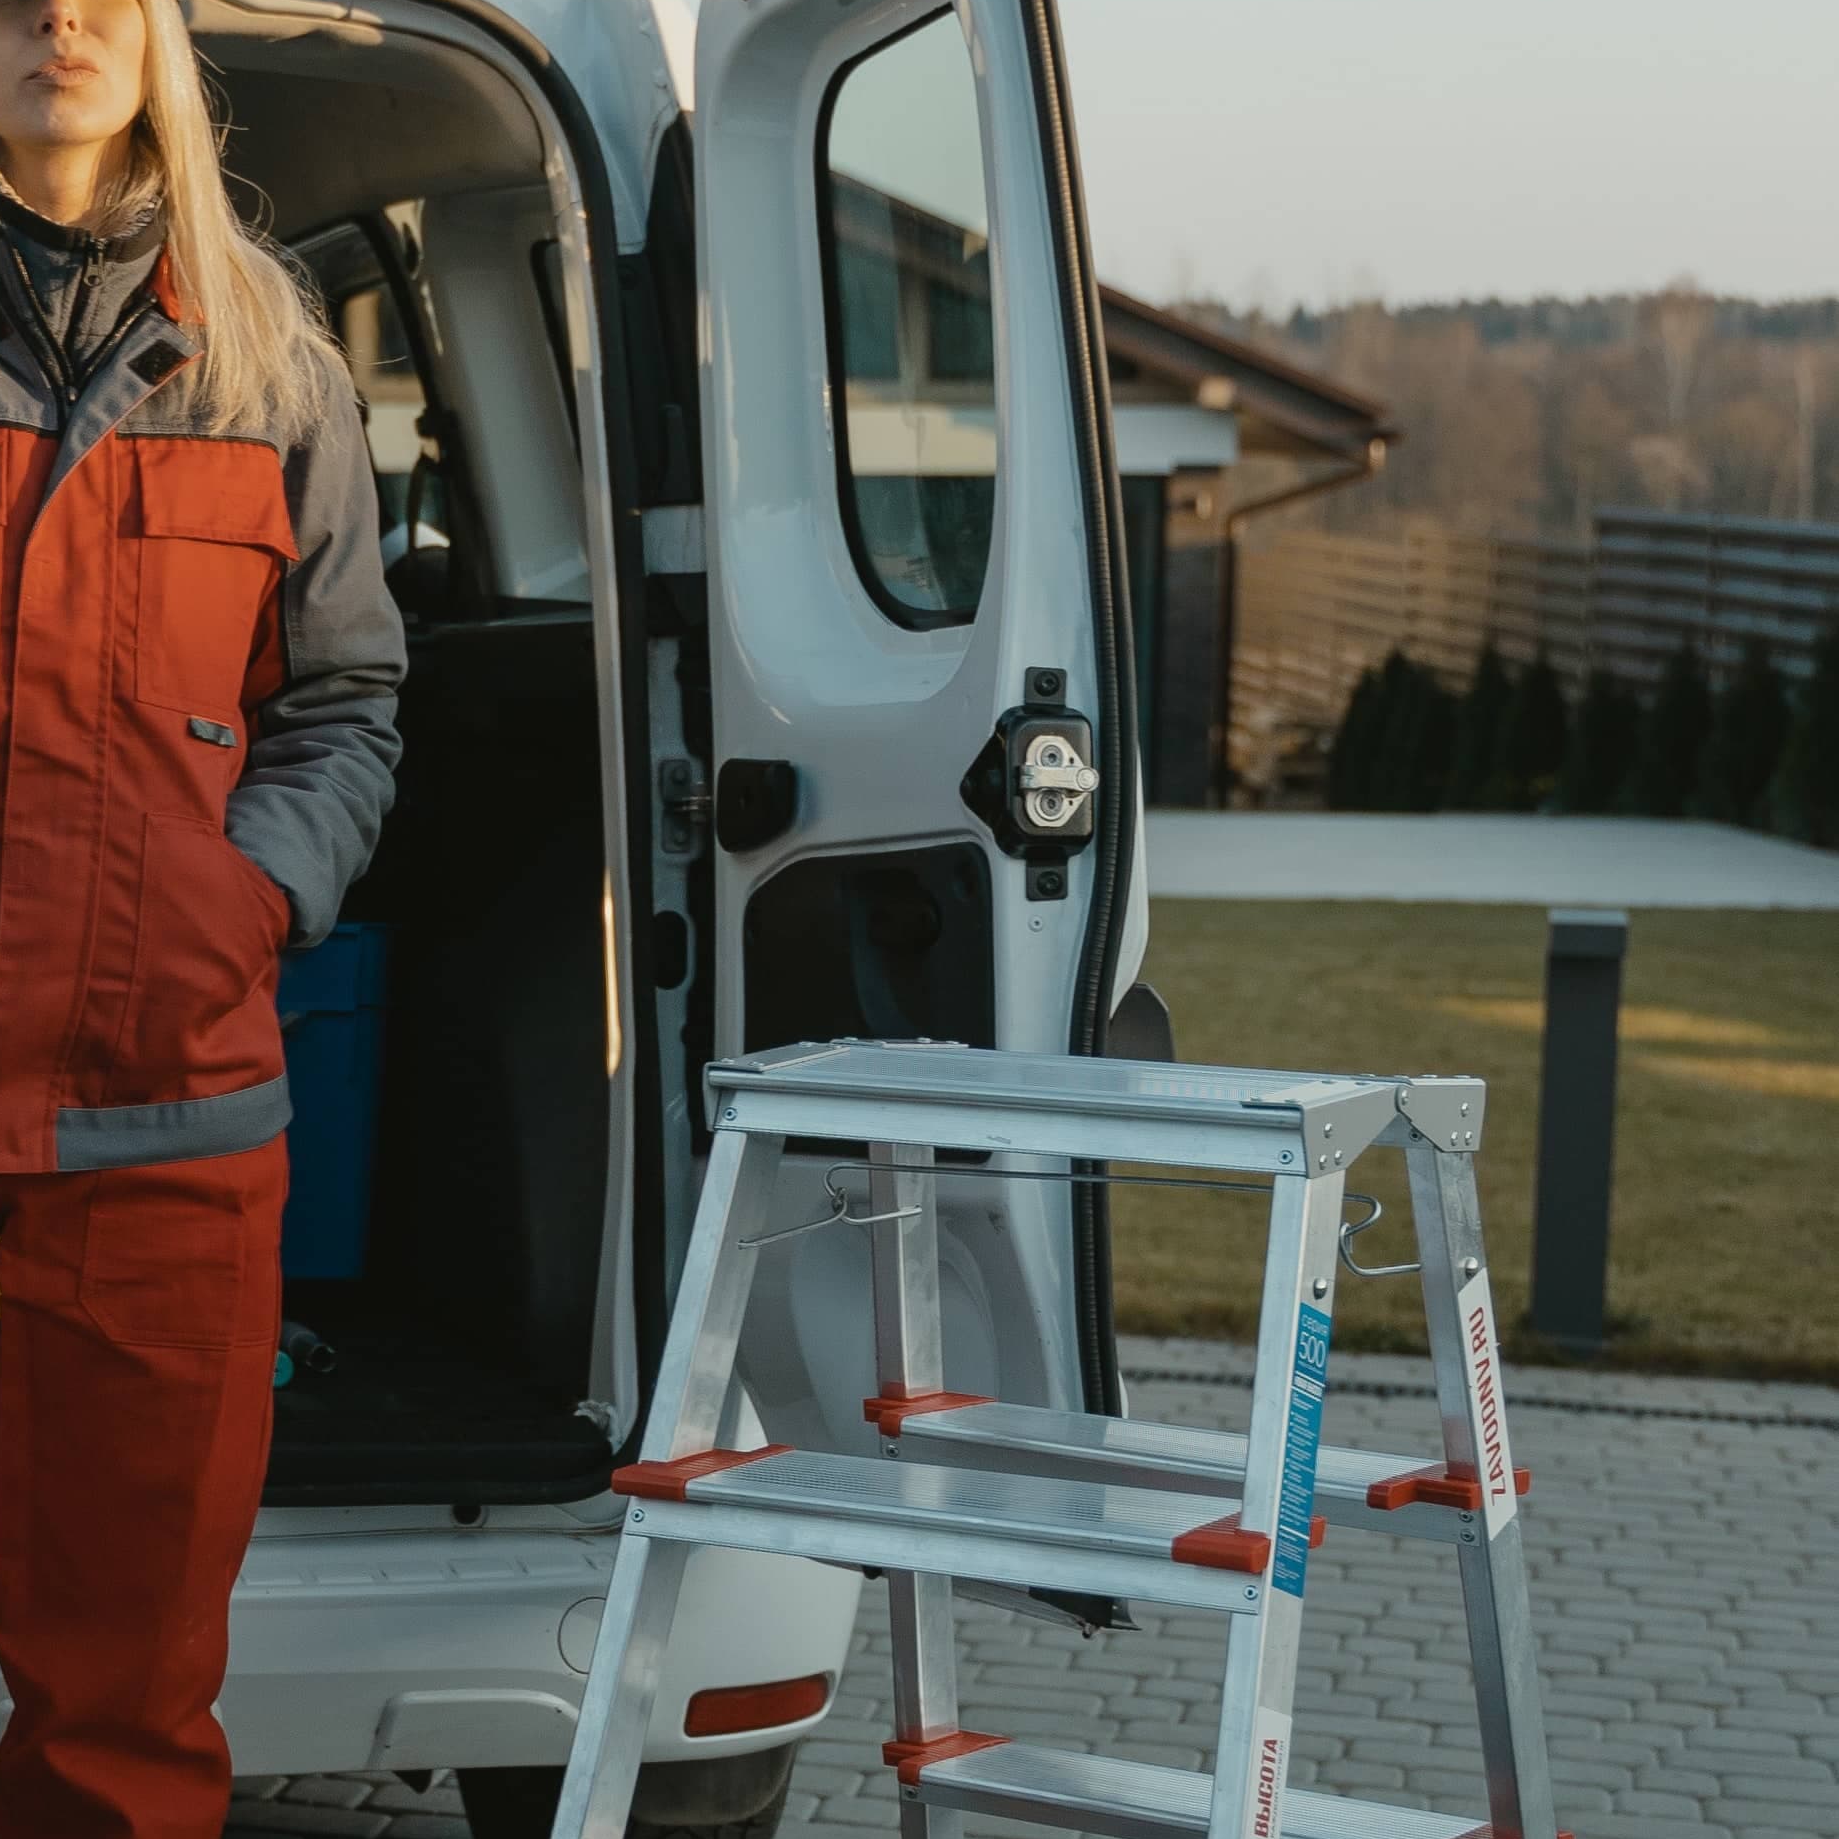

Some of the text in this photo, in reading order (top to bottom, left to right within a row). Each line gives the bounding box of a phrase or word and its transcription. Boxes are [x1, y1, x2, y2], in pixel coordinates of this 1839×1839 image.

[1298, 1331, 1326, 1368] 500
[1468, 1306, 1507, 1507] ZAVODNV.RU
[1254, 1739, 1278, 1837] ВЫСОТА
